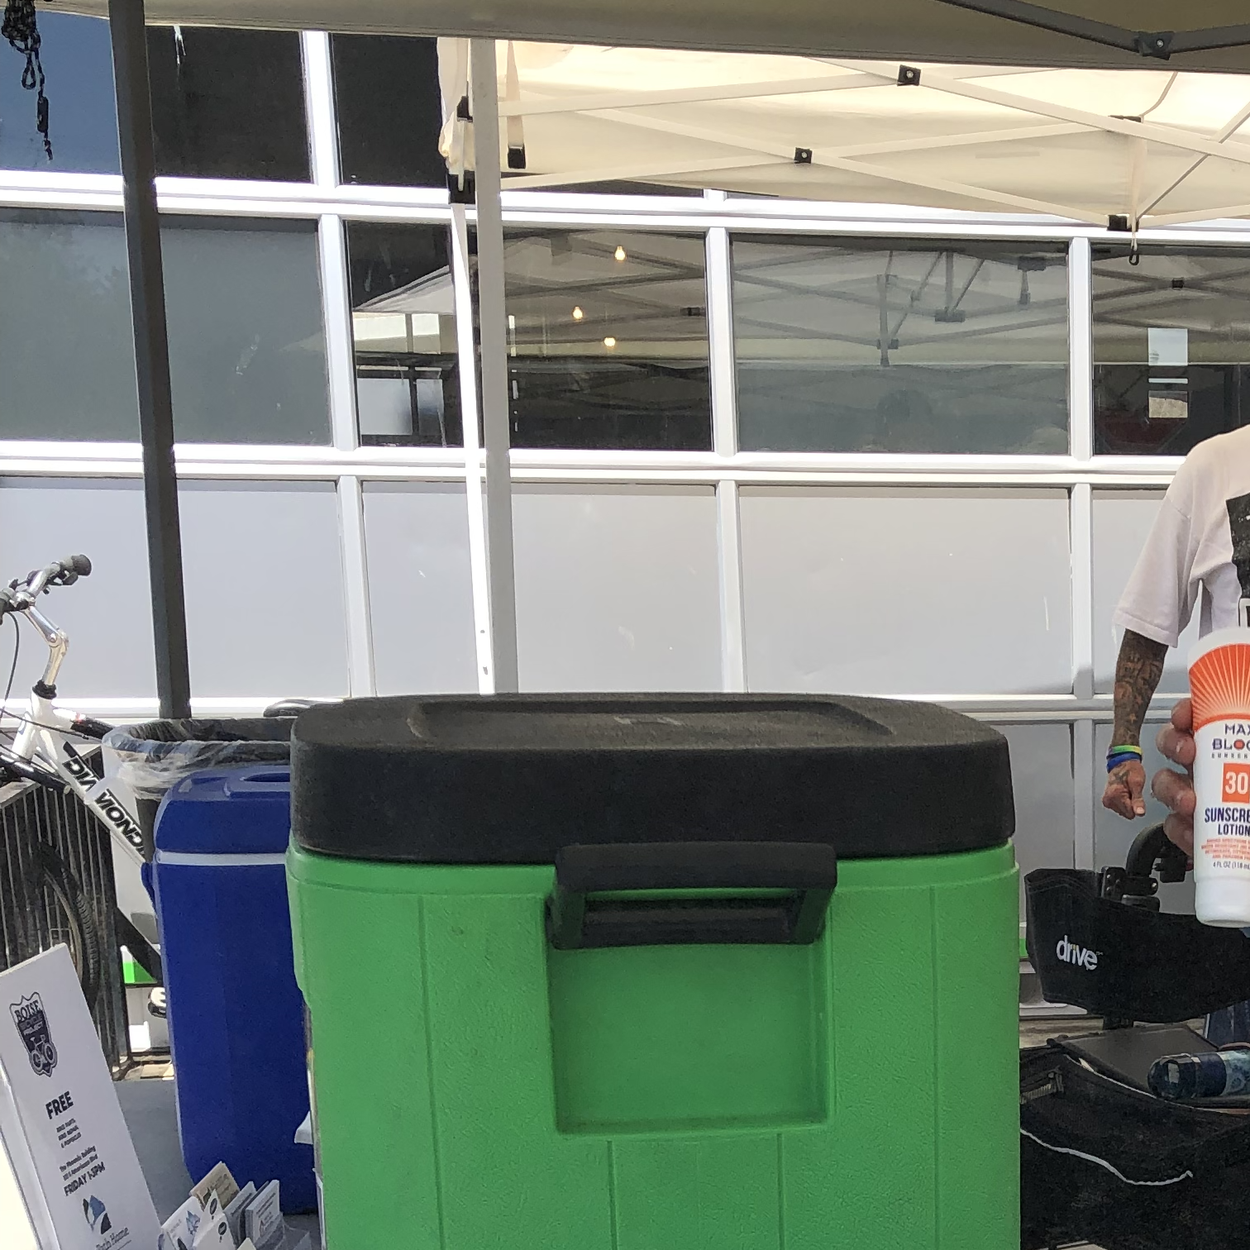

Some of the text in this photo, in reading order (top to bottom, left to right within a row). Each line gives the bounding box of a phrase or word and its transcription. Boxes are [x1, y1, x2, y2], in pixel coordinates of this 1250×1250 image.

[1225, 772, 1249, 795] 30
[1217, 824, 1250, 836] LOTION
[1056, 934, 1098, 971] drive
[14, 999, 40, 1022] BOISE
[45, 1090, 74, 1120] FREE
[63, 1172, 87, 1197] FRIDAY
